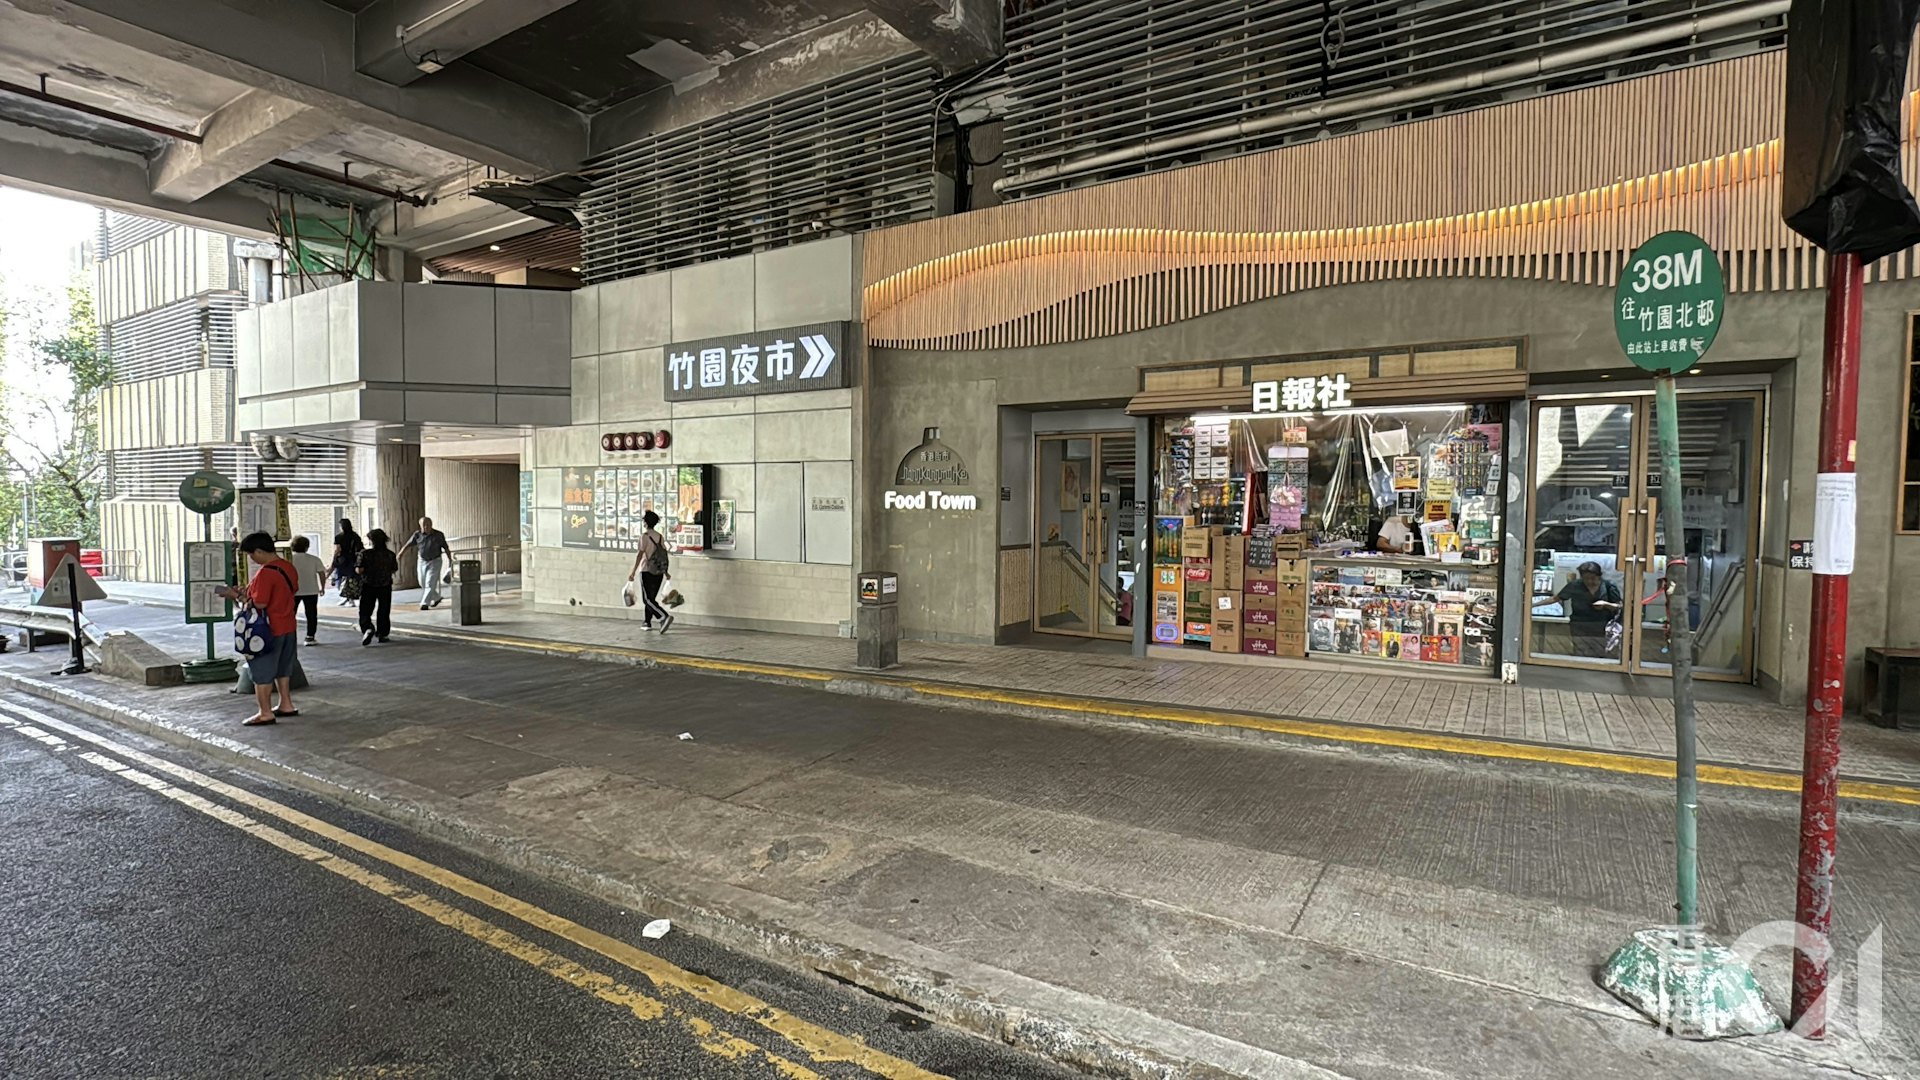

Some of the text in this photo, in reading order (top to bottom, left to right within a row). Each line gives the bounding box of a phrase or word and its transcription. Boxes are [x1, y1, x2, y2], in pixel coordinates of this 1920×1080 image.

[1632, 249, 1702, 293] 38M
[1627, 338, 1688, 355] 由此站上車收費
[667, 338, 796, 391] 竹園夜市
[1253, 374, 1352, 412] 日報社
[884, 490, 977, 510] Food Town
[1464, 627, 1481, 636] GQ
